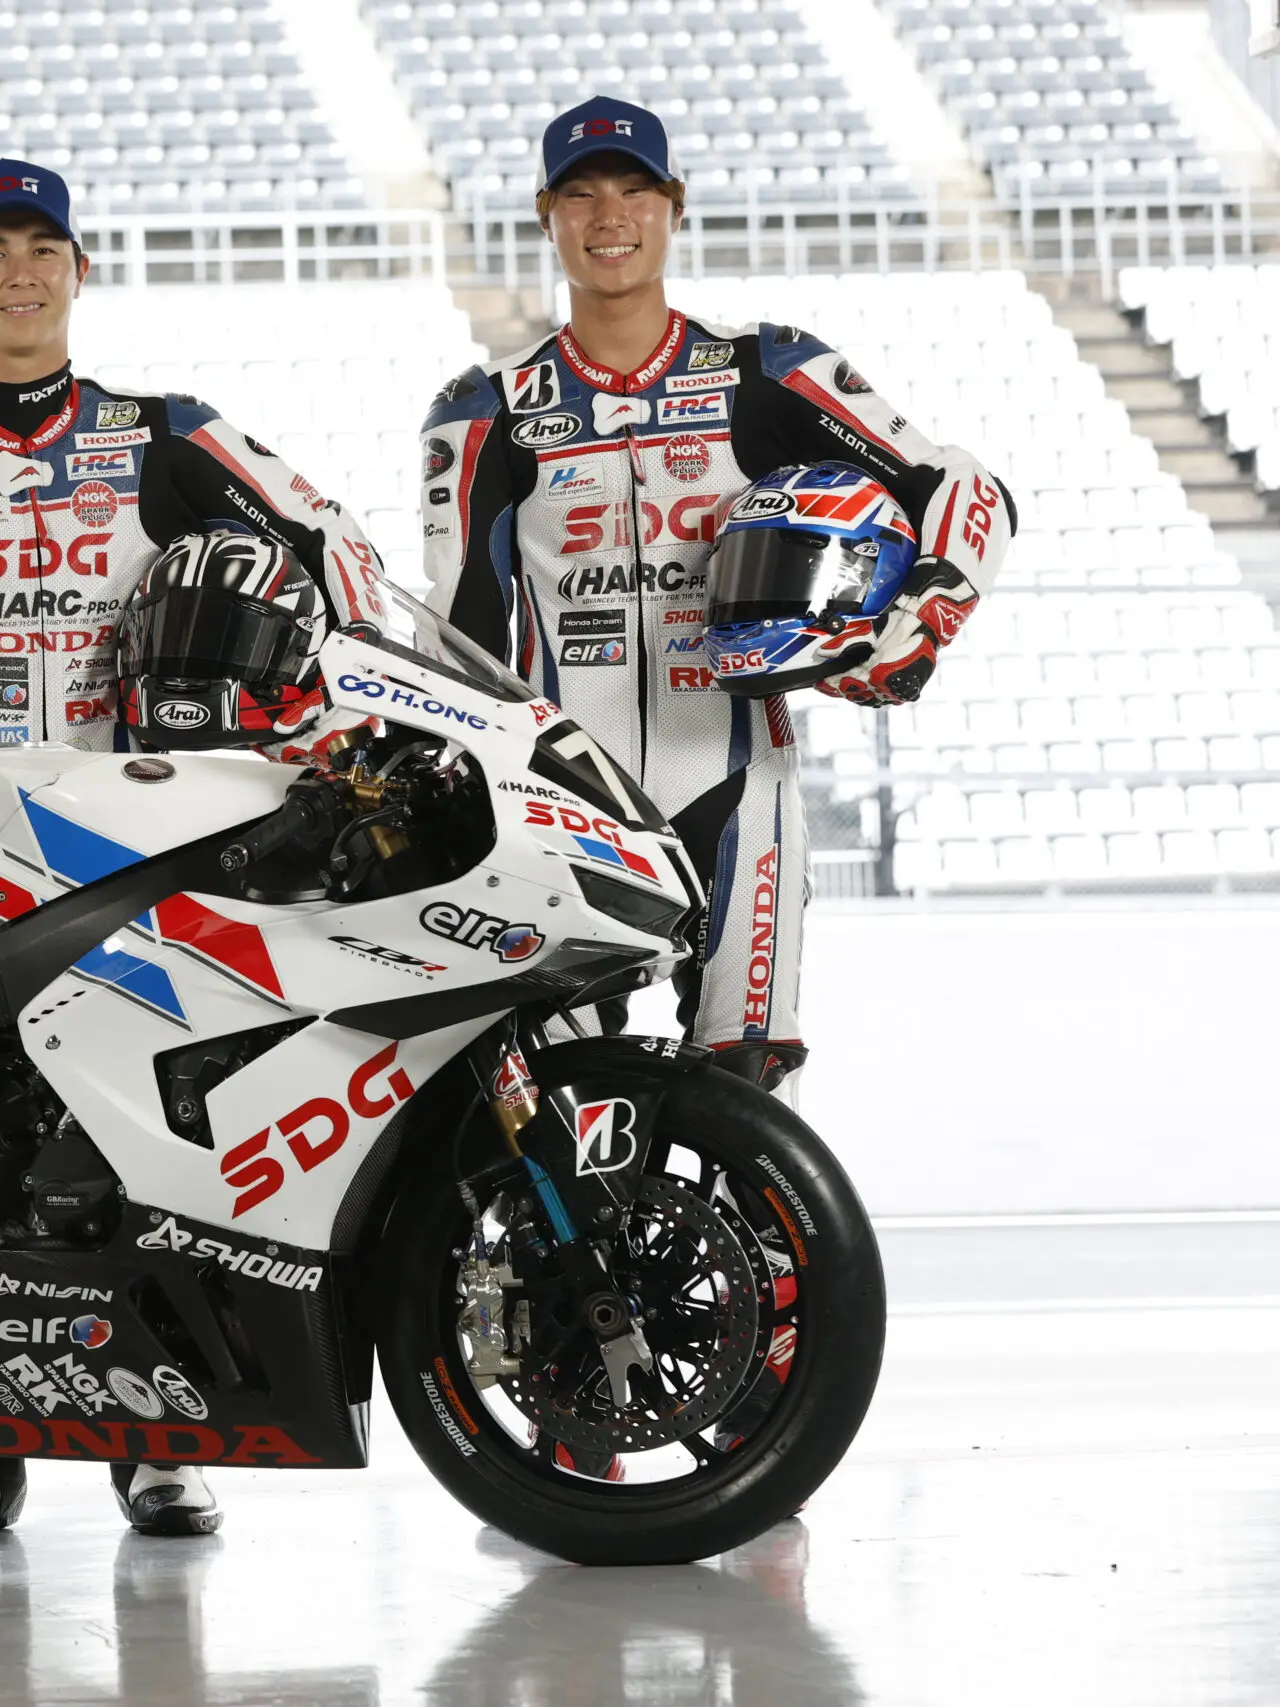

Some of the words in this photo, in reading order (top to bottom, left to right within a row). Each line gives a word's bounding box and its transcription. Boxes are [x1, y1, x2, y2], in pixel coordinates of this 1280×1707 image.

[567, 118, 633, 144] SDG
[18, 375, 68, 404] FIXFIT
[672, 374, 734, 389] HONDA
[662, 395, 722, 417] HRC
[31, 404, 73, 445] KUSHITAN
[519, 416, 570, 440] Arai
[82, 432, 145, 445] HONDA
[670, 444, 703, 457] NGK
[71, 453, 128, 473] HRC
[673, 467, 703, 475] PLUGS
[78, 491, 110, 504] NGK
[548, 488, 567, 497] Exceed
[567, 485, 602, 496] expectations
[81, 507, 110, 515] SPARK
[81, 513, 112, 522] PLUGS
[731, 495, 786, 518] Arai
[962, 472, 1000, 563] SDG
[560, 494, 720, 554] SDG
[582, 597, 617, 605] ADVANCED
[563, 618, 591, 627] Honda
[592, 617, 623, 626] Dream
[86, 657, 116, 667] SHOWA
[564, 644, 603, 662] elf
[720, 650, 763, 671] SDG
[670, 666, 715, 687] RK
[65, 698, 112, 722] RK
[158, 703, 202, 722] Arai
[524, 801, 624, 847] SDG
[419, 901, 510, 951] elf
[743, 845, 778, 1027] HONDA
[339, 946, 434, 981] FIREBLADE
[504, 1086, 540, 1110] SHOW
[220, 1040, 416, 1220] SDG
[755, 1153, 818, 1237] BRIDGESTONE
[187, 1237, 324, 1292] SHOWA
[0, 1353, 73, 1414] RK
[43, 1363, 70, 1392] SPARK
[68, 1388, 94, 1417] PLUGS
[52, 1352, 118, 1413] NGK
[157, 1367, 203, 1416] Arai
[28, 1396, 51, 1418] CHAIN
[419, 1371, 478, 1457] BRIDGESTONE
